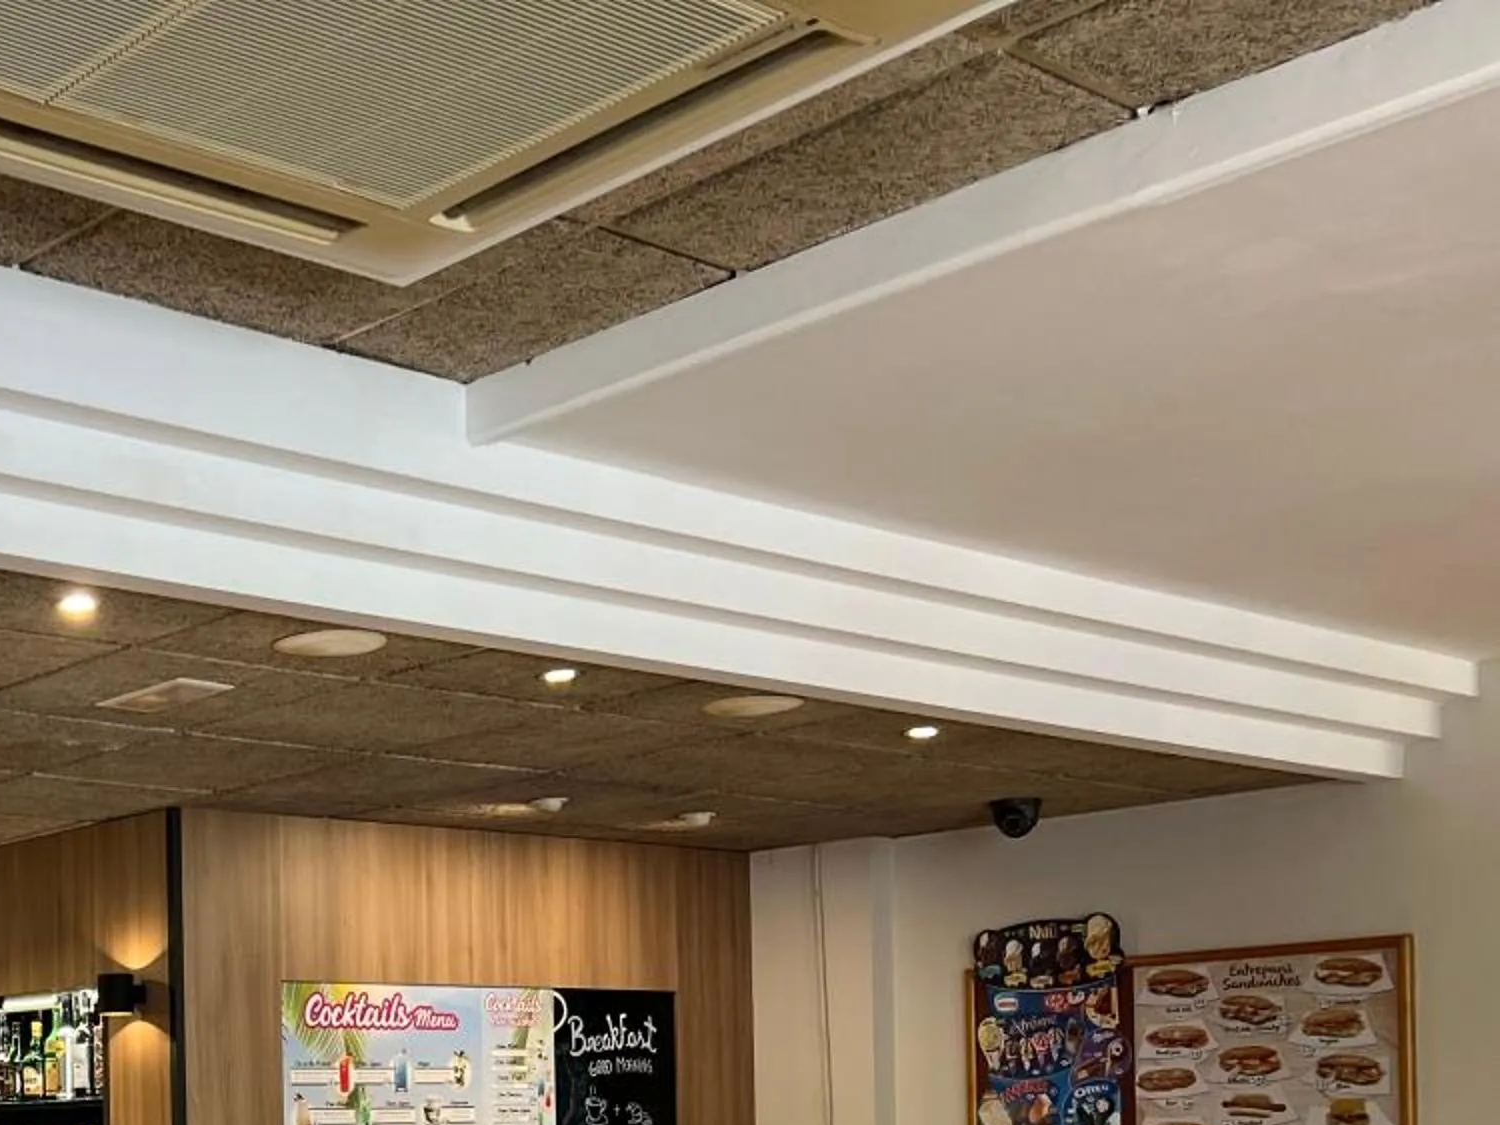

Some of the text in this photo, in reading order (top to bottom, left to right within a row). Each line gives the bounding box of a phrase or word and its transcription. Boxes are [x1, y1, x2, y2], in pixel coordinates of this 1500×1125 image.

[1223, 973, 1301, 991] Sandwiches
[305, 992, 412, 1031] Cocktails
[412, 1005, 459, 1031] Menu
